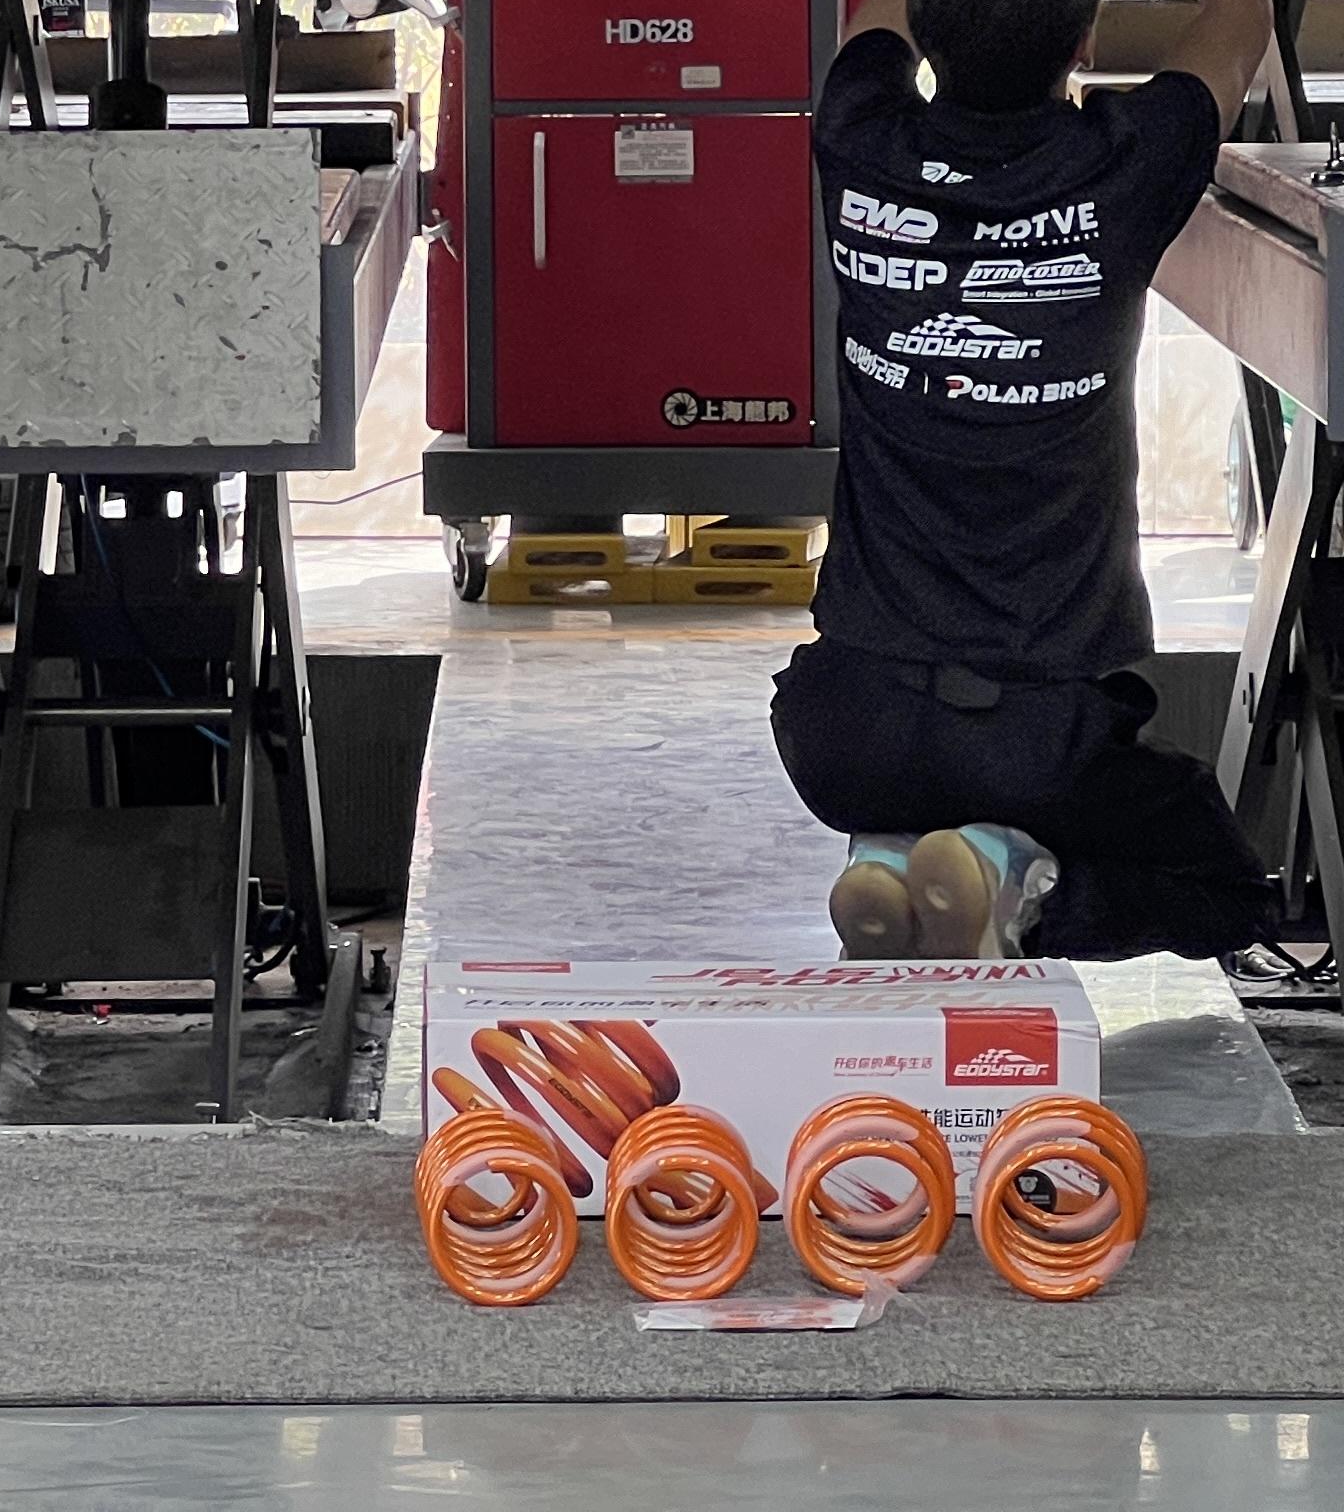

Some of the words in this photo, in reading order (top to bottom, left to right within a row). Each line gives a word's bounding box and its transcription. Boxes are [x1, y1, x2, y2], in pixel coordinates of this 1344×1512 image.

[604, 18, 695, 45] HD628
[832, 240, 948, 291] CIDEP
[945, 374, 1040, 405] POLAR
[1041, 372, 1107, 404] BROS
[955, 1133, 989, 1144] LOWE
